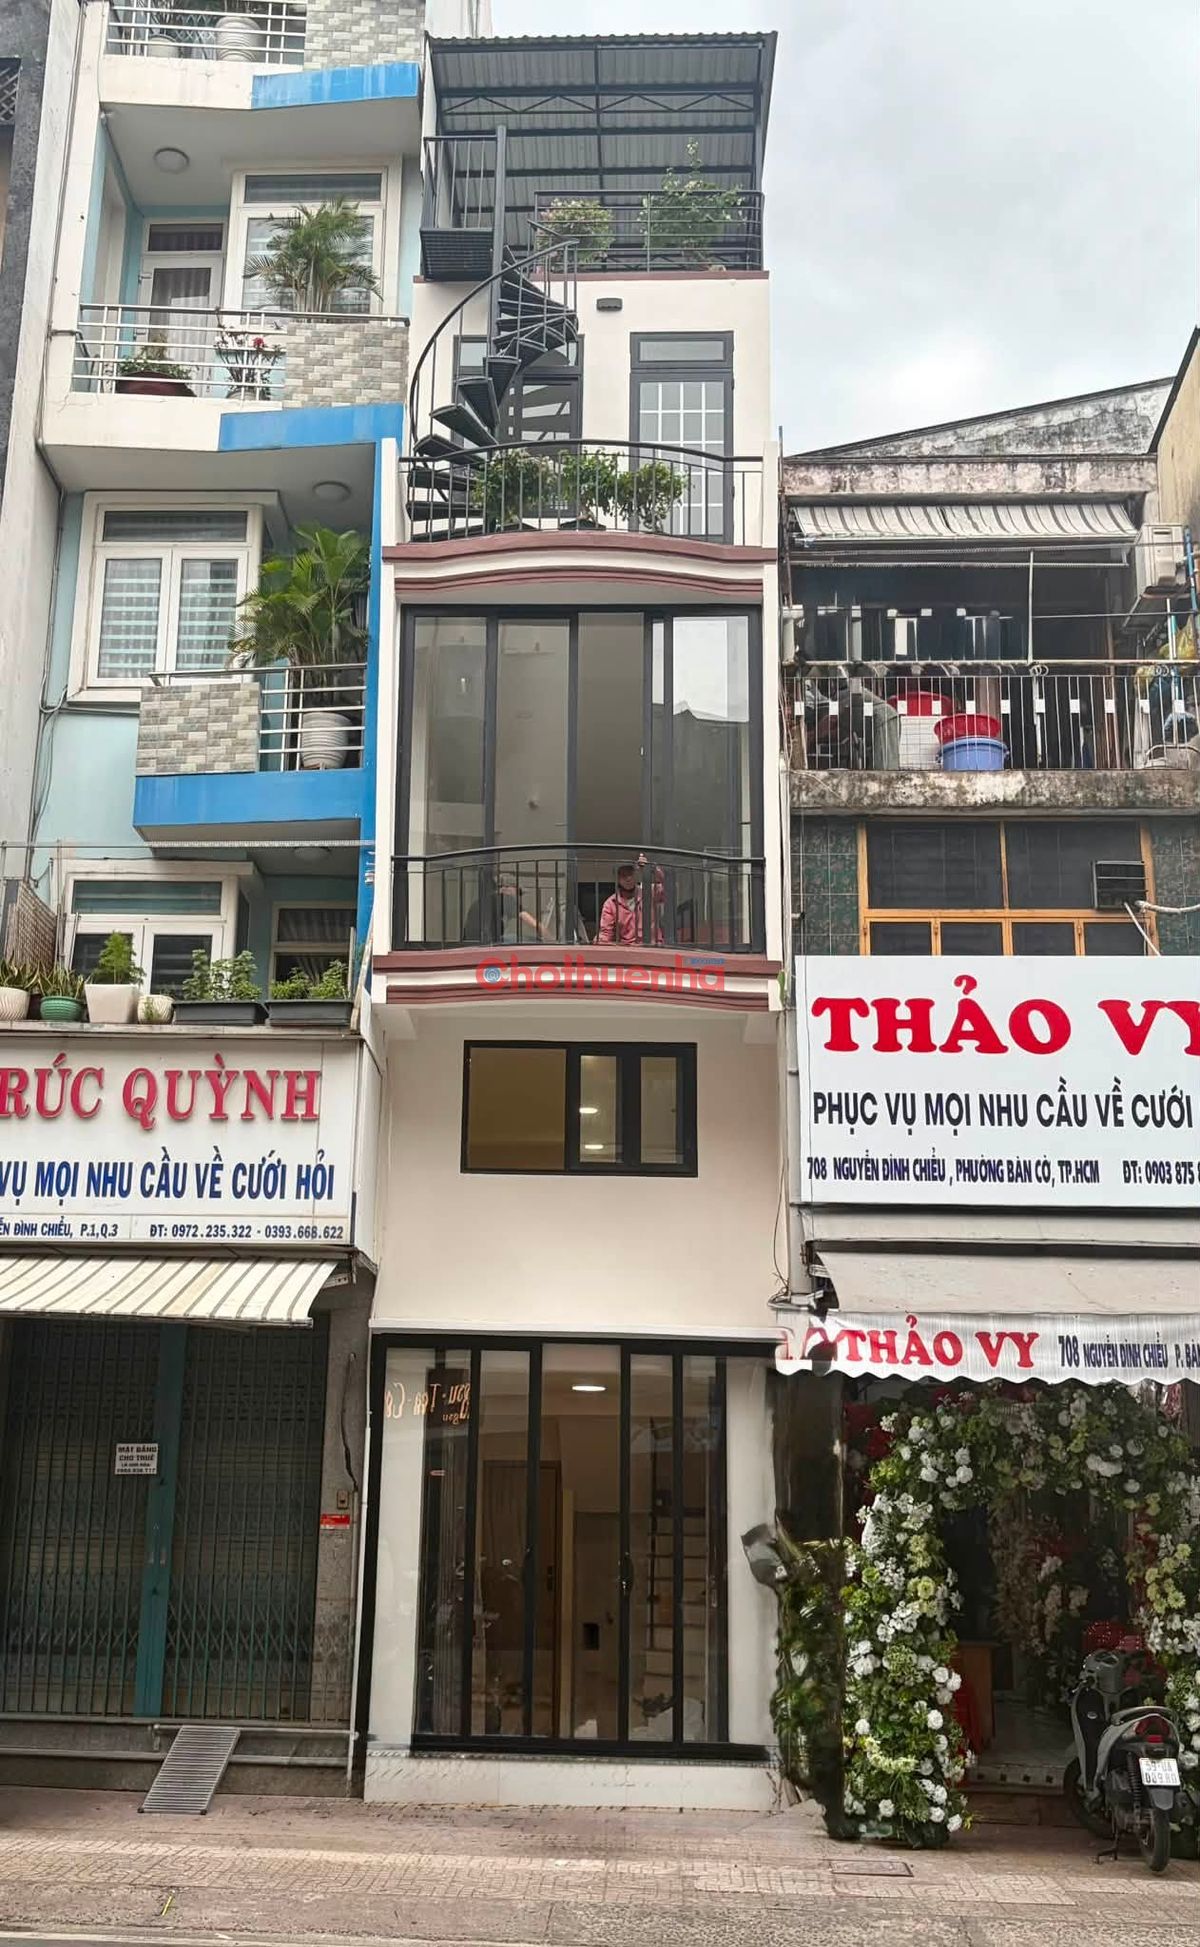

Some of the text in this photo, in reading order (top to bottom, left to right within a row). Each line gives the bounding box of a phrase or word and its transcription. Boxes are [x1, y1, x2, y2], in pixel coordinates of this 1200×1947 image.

[811, 975, 1071, 1055] THẢO
[122, 1053, 322, 1130] QUỲNH
[813, 1076, 1193, 1136] PHỤC VỤ MỌI NHU CẦU VỀ CƯỚI
[34, 1161, 79, 1206] MỌI
[86, 1162, 133, 1198] NHU
[140, 1146, 188, 1198] CẦU
[195, 1145, 223, 1199] VỀ
[232, 1150, 287, 1200] CƯỚI
[295, 1149, 335, 1200] HỎI
[807, 1157, 827, 1180] 708
[1006, 1155, 1033, 1183] BÀN
[1058, 1160, 1100, 1183] TP.HCM
[1122, 1160, 1143, 1184] ĐT:
[14, 1220, 37, 1236] ĐÌNH
[148, 1224, 167, 1237] ĐT:
[837, 1314, 1039, 1368] THẢO VY
[1058, 1335, 1079, 1367] 708
